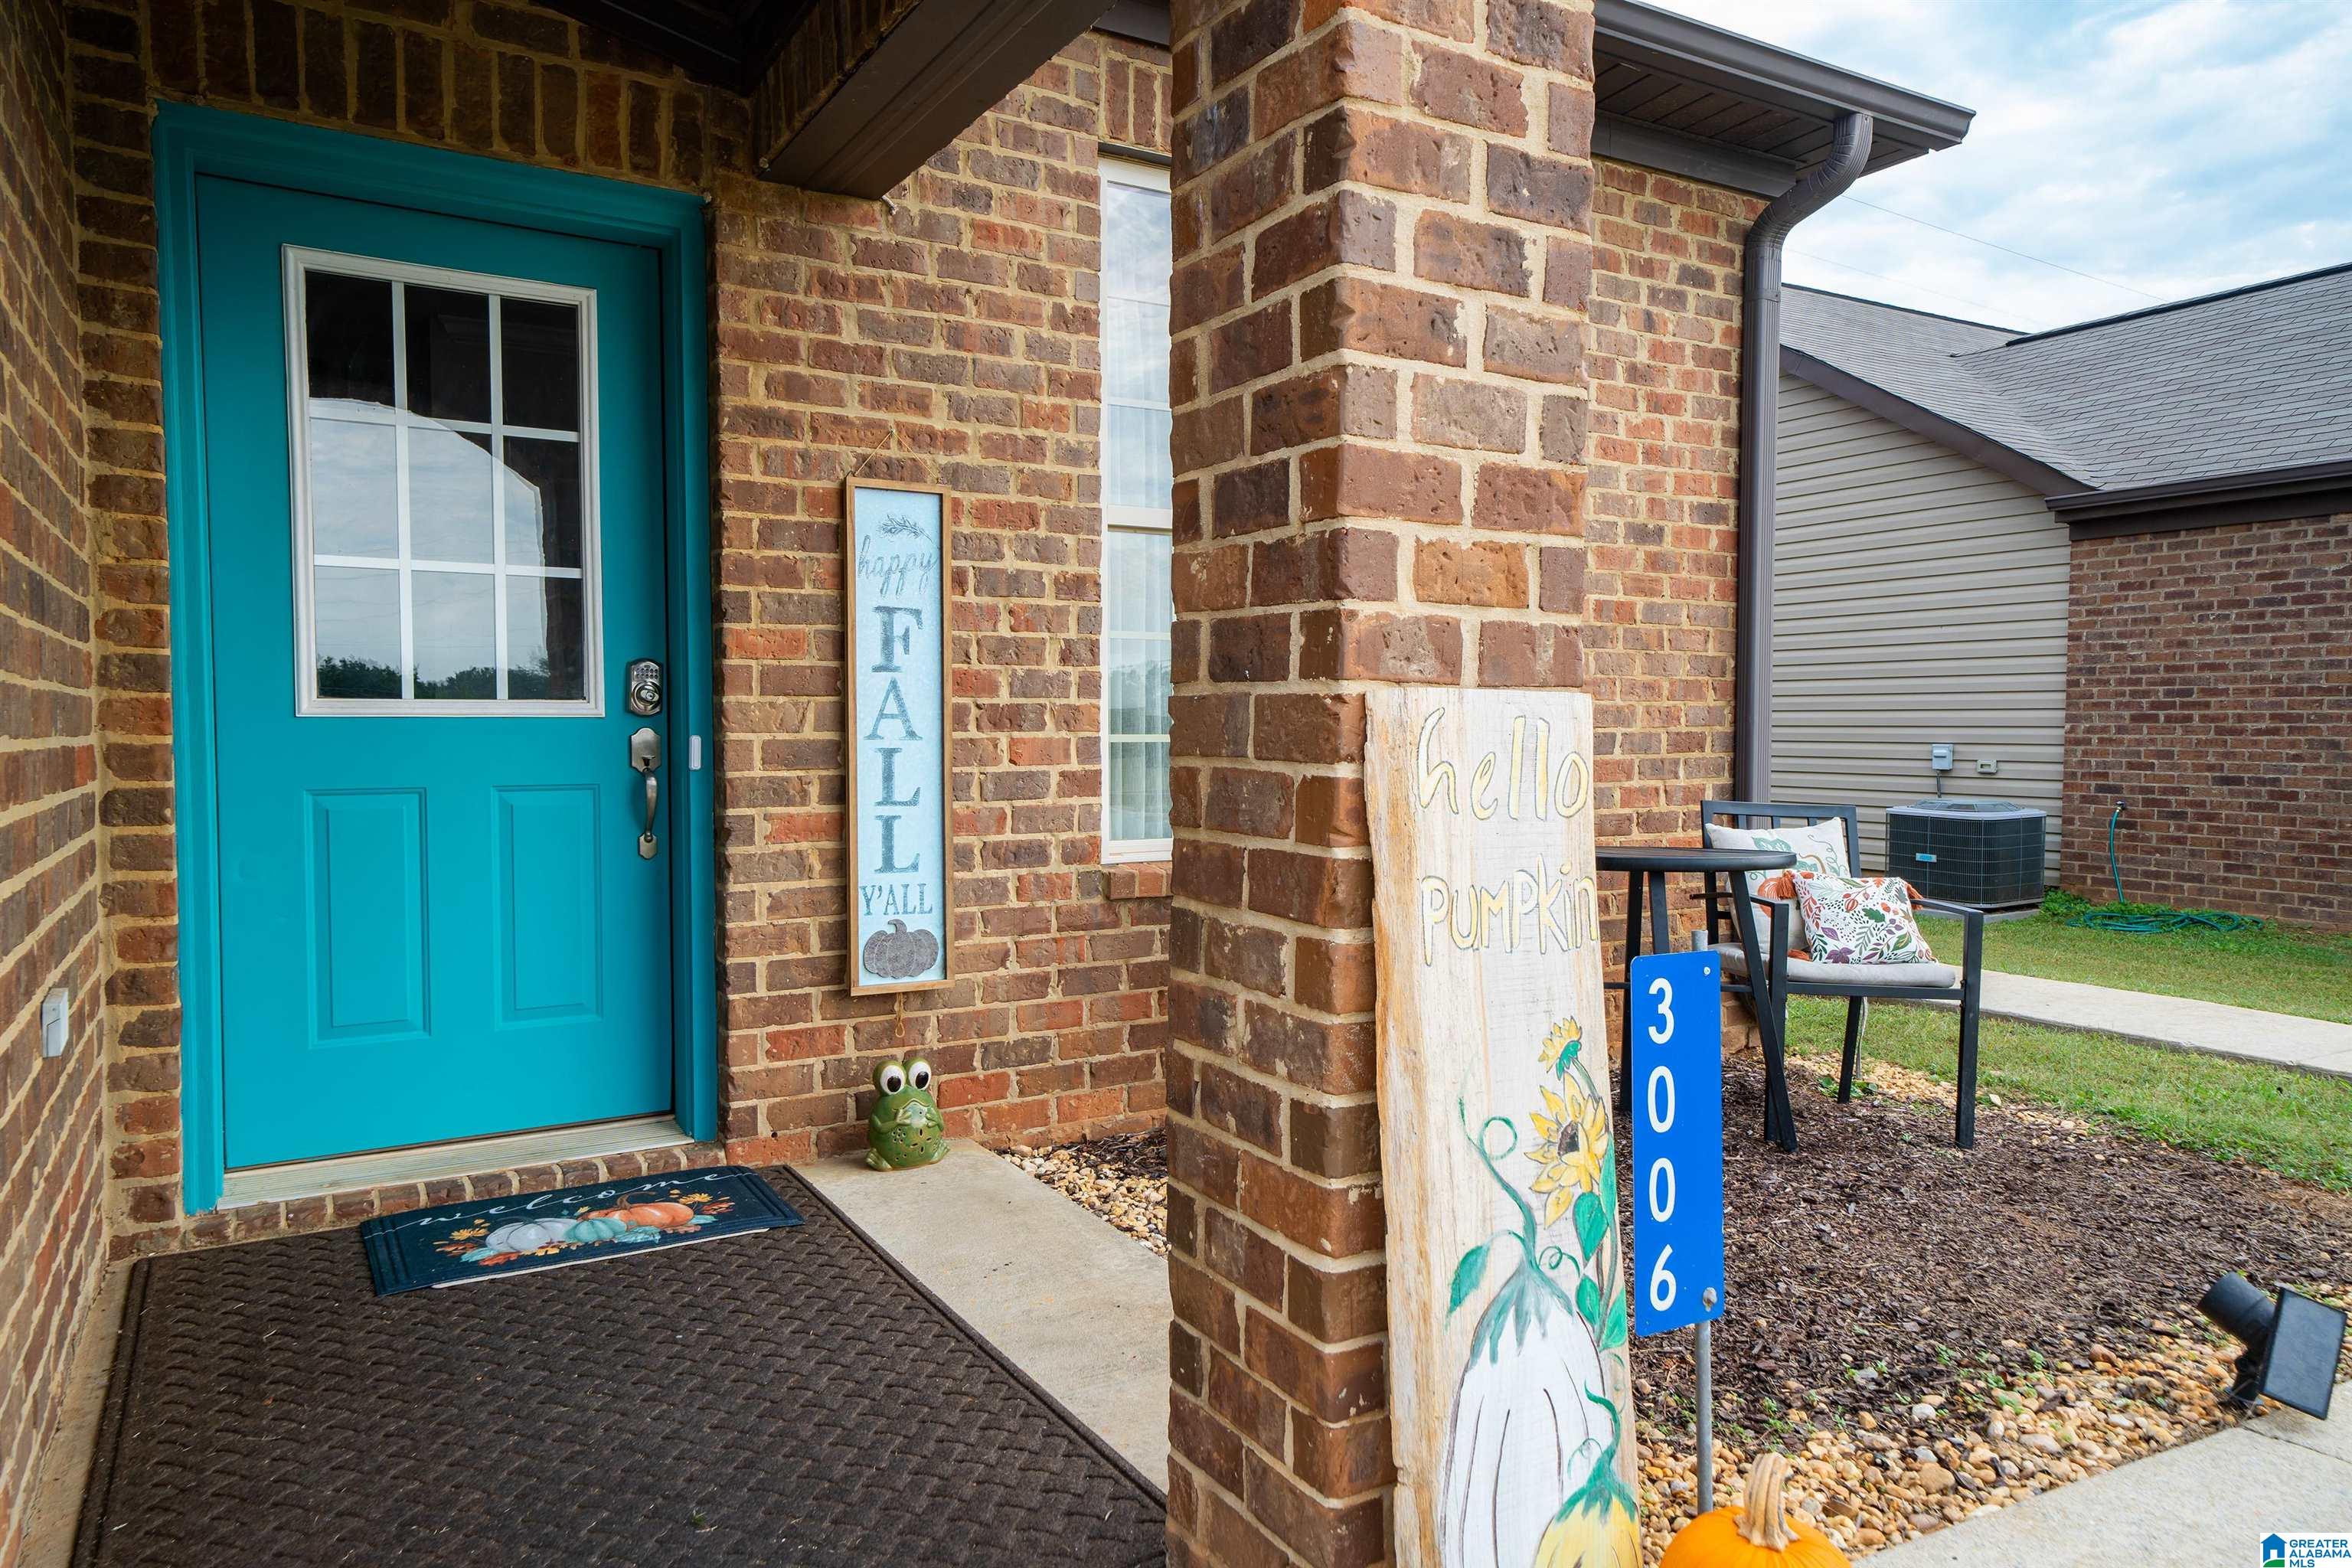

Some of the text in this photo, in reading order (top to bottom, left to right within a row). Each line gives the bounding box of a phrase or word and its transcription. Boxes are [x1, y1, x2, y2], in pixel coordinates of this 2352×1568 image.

[858, 534, 938, 599] happy
[863, 605, 923, 874] FALL
[1417, 707, 1589, 822] hello
[858, 883, 933, 916] Y'ALL
[1647, 977, 1677, 1312] 3006
[410, 1173, 729, 1226] welcome
